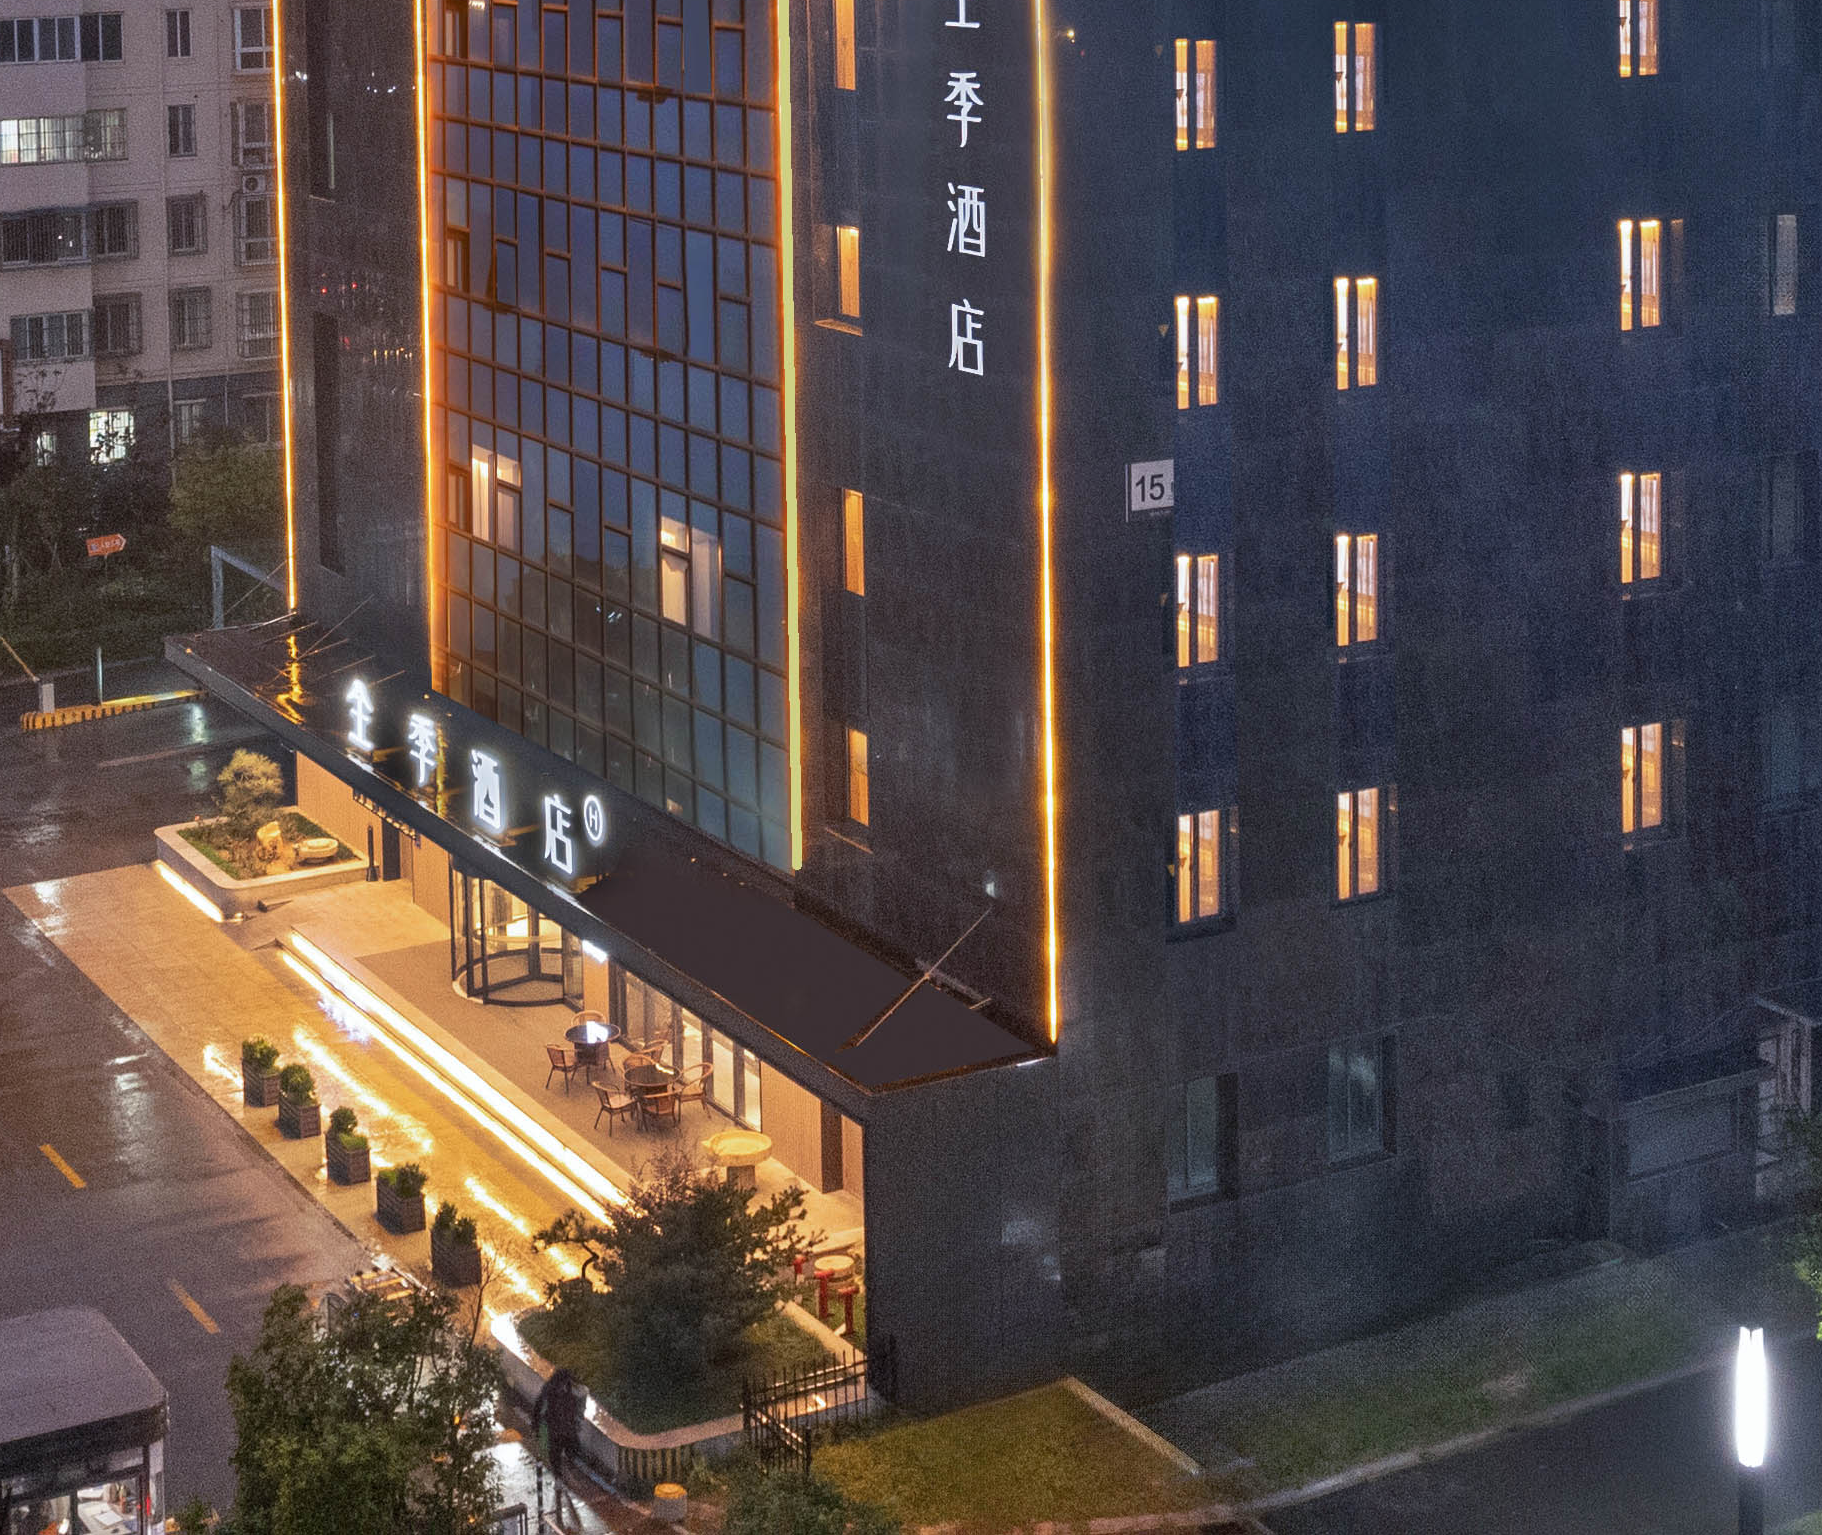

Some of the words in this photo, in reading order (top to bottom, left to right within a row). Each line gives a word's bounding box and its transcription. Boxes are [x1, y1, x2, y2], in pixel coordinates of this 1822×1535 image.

[1135, 474, 1164, 502] 15
[346, 678, 573, 875] 全季酒店
